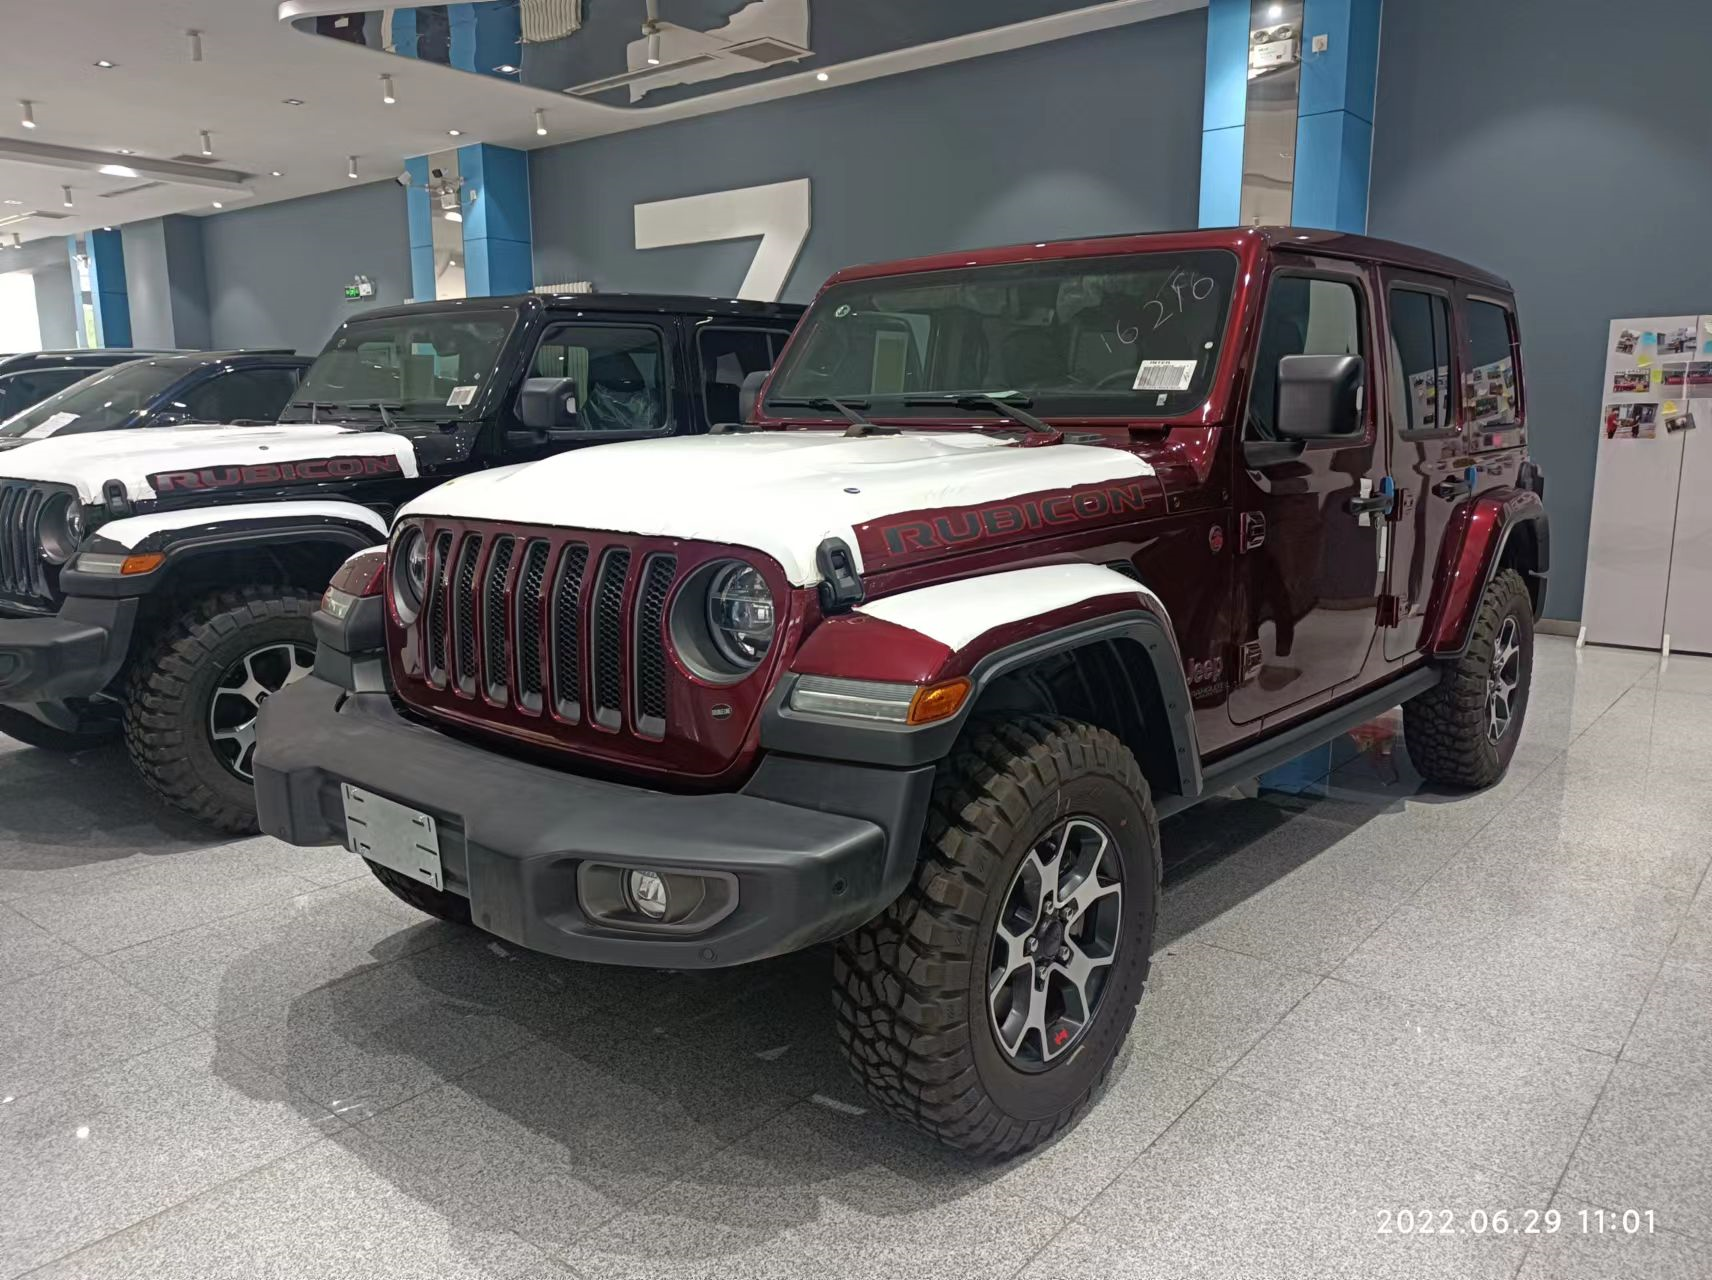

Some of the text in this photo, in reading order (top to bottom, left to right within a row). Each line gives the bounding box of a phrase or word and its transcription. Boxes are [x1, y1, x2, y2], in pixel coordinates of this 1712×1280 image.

[634, 178, 811, 303] 7
[156, 454, 402, 491] RUBICON
[881, 483, 1146, 554] RUBICON
[1187, 656, 1223, 684] Jeep
